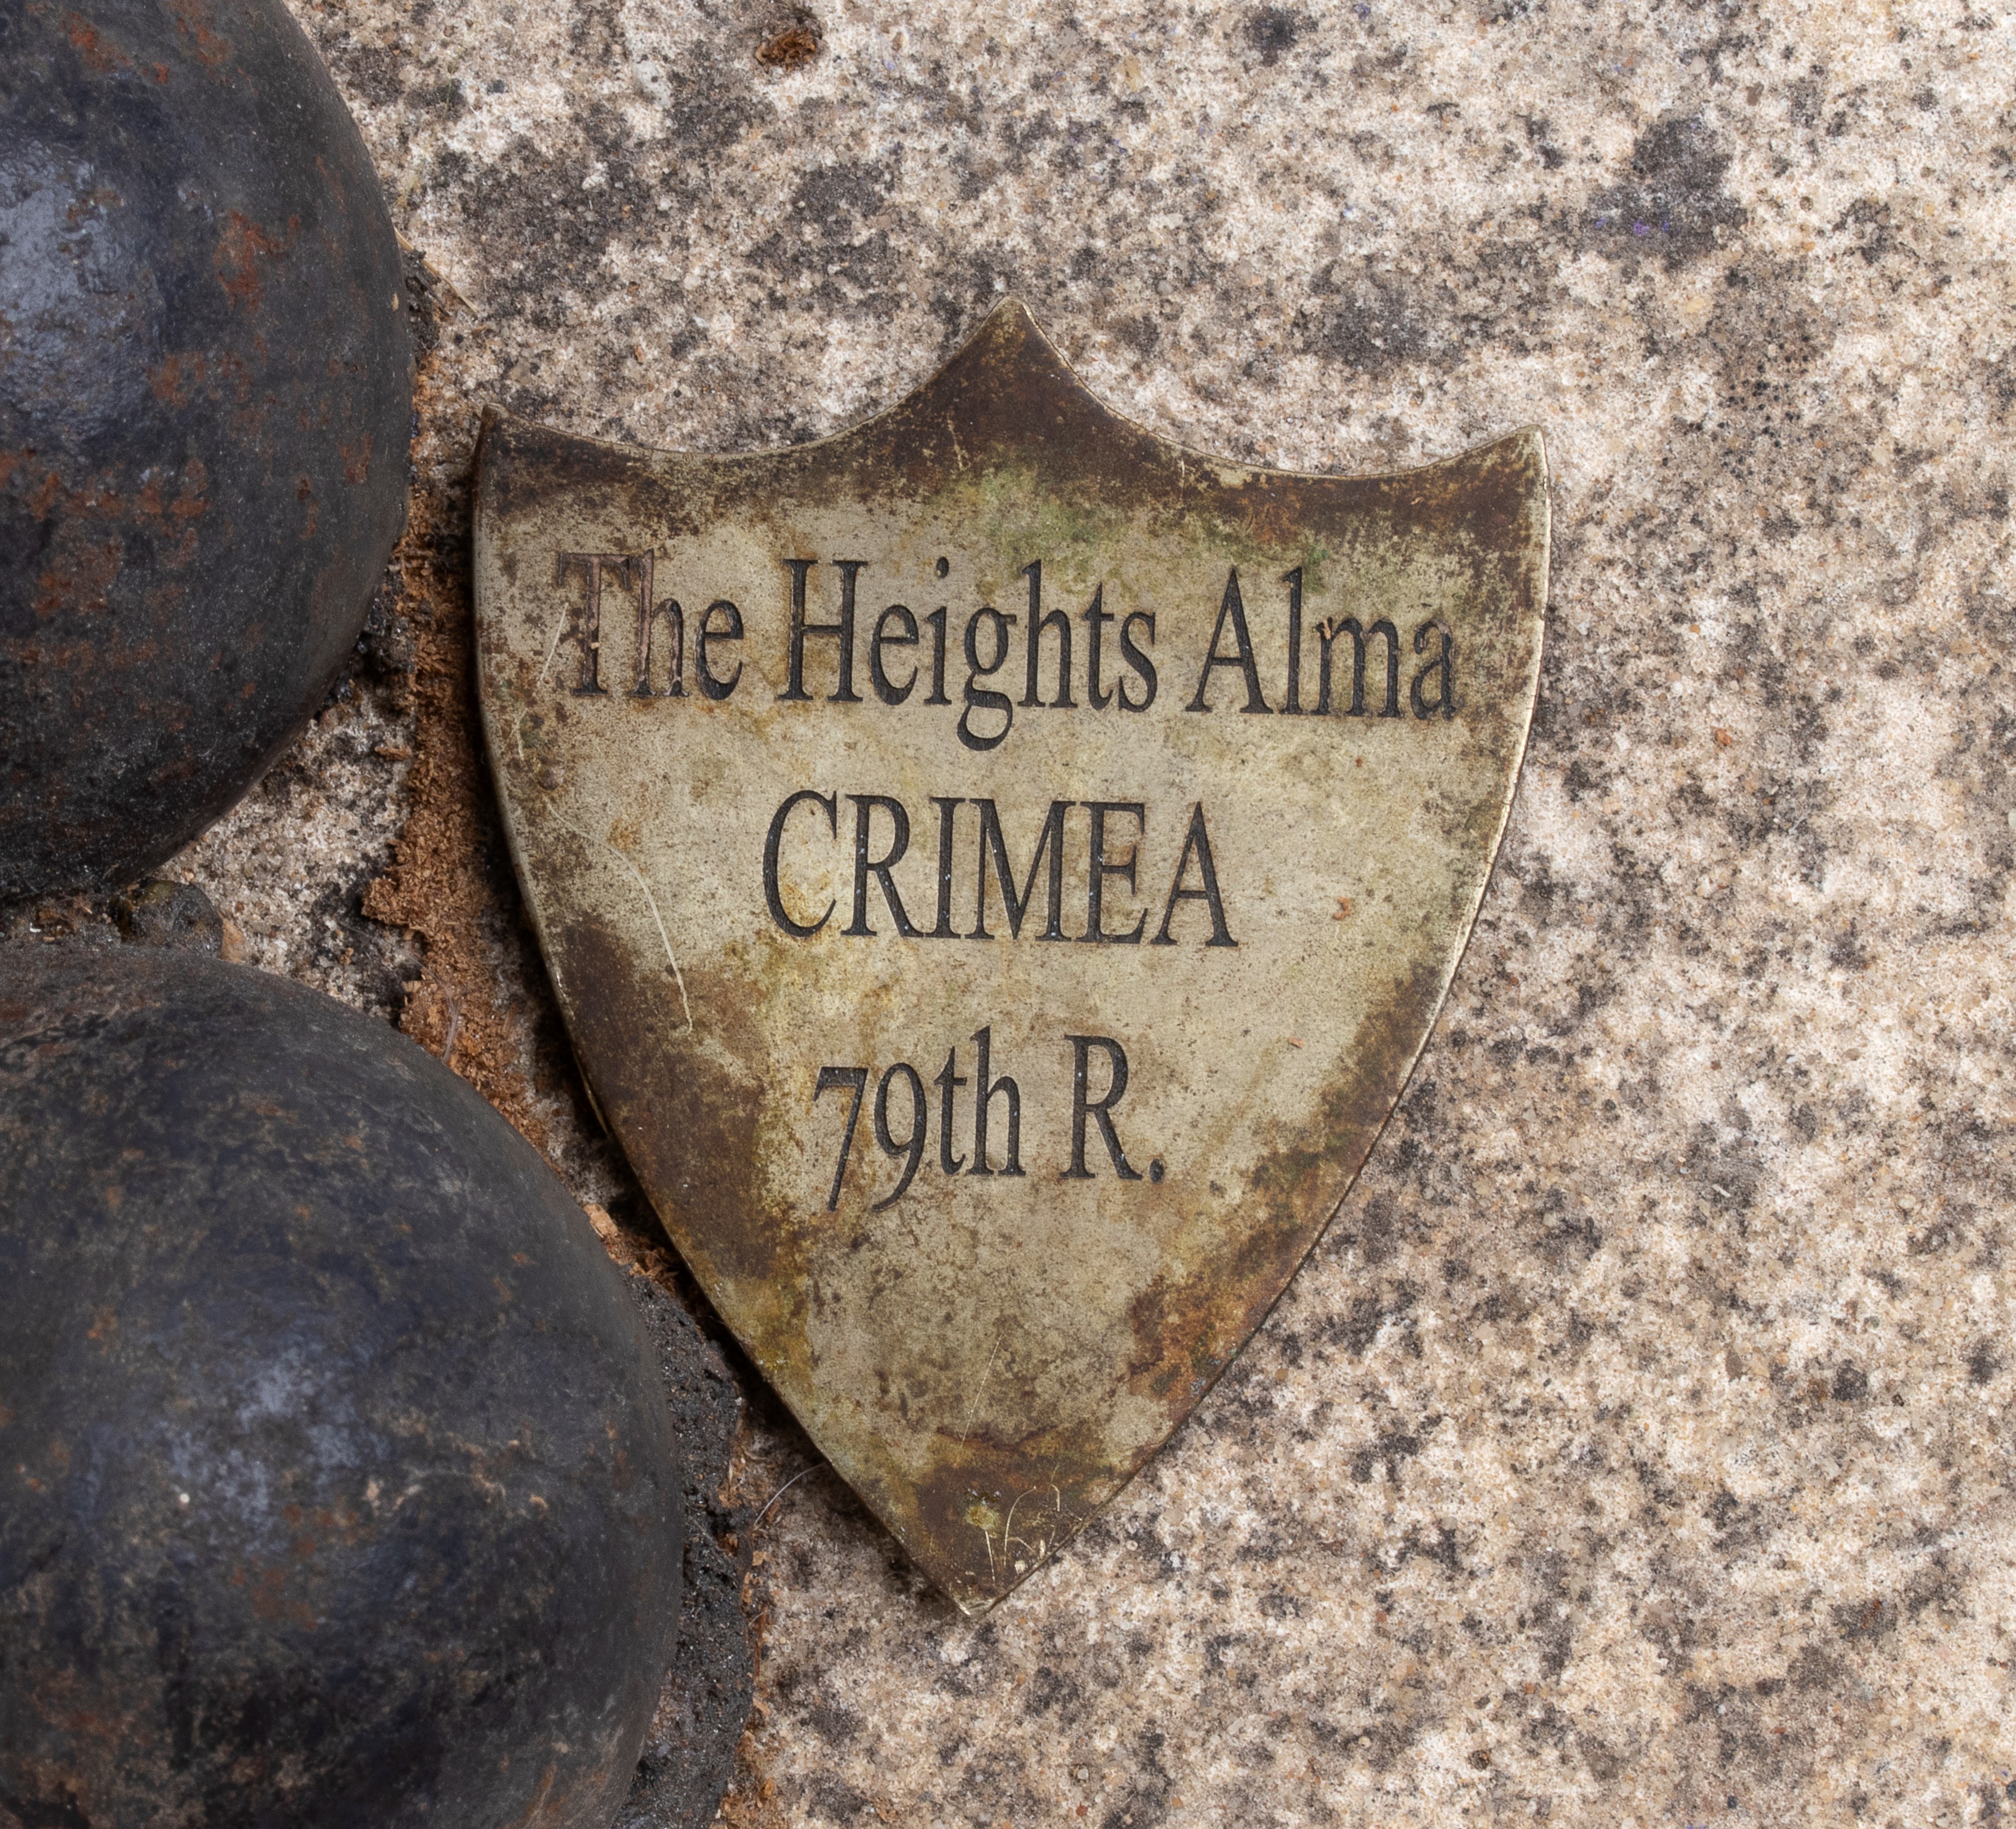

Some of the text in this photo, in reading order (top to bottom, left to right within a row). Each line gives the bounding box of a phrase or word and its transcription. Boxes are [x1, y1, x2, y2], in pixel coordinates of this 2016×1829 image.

[557, 548, 1457, 751] The Heights Alma
[762, 790, 1239, 947] CRIMEA
[813, 1025, 1164, 1212] 79th R.
